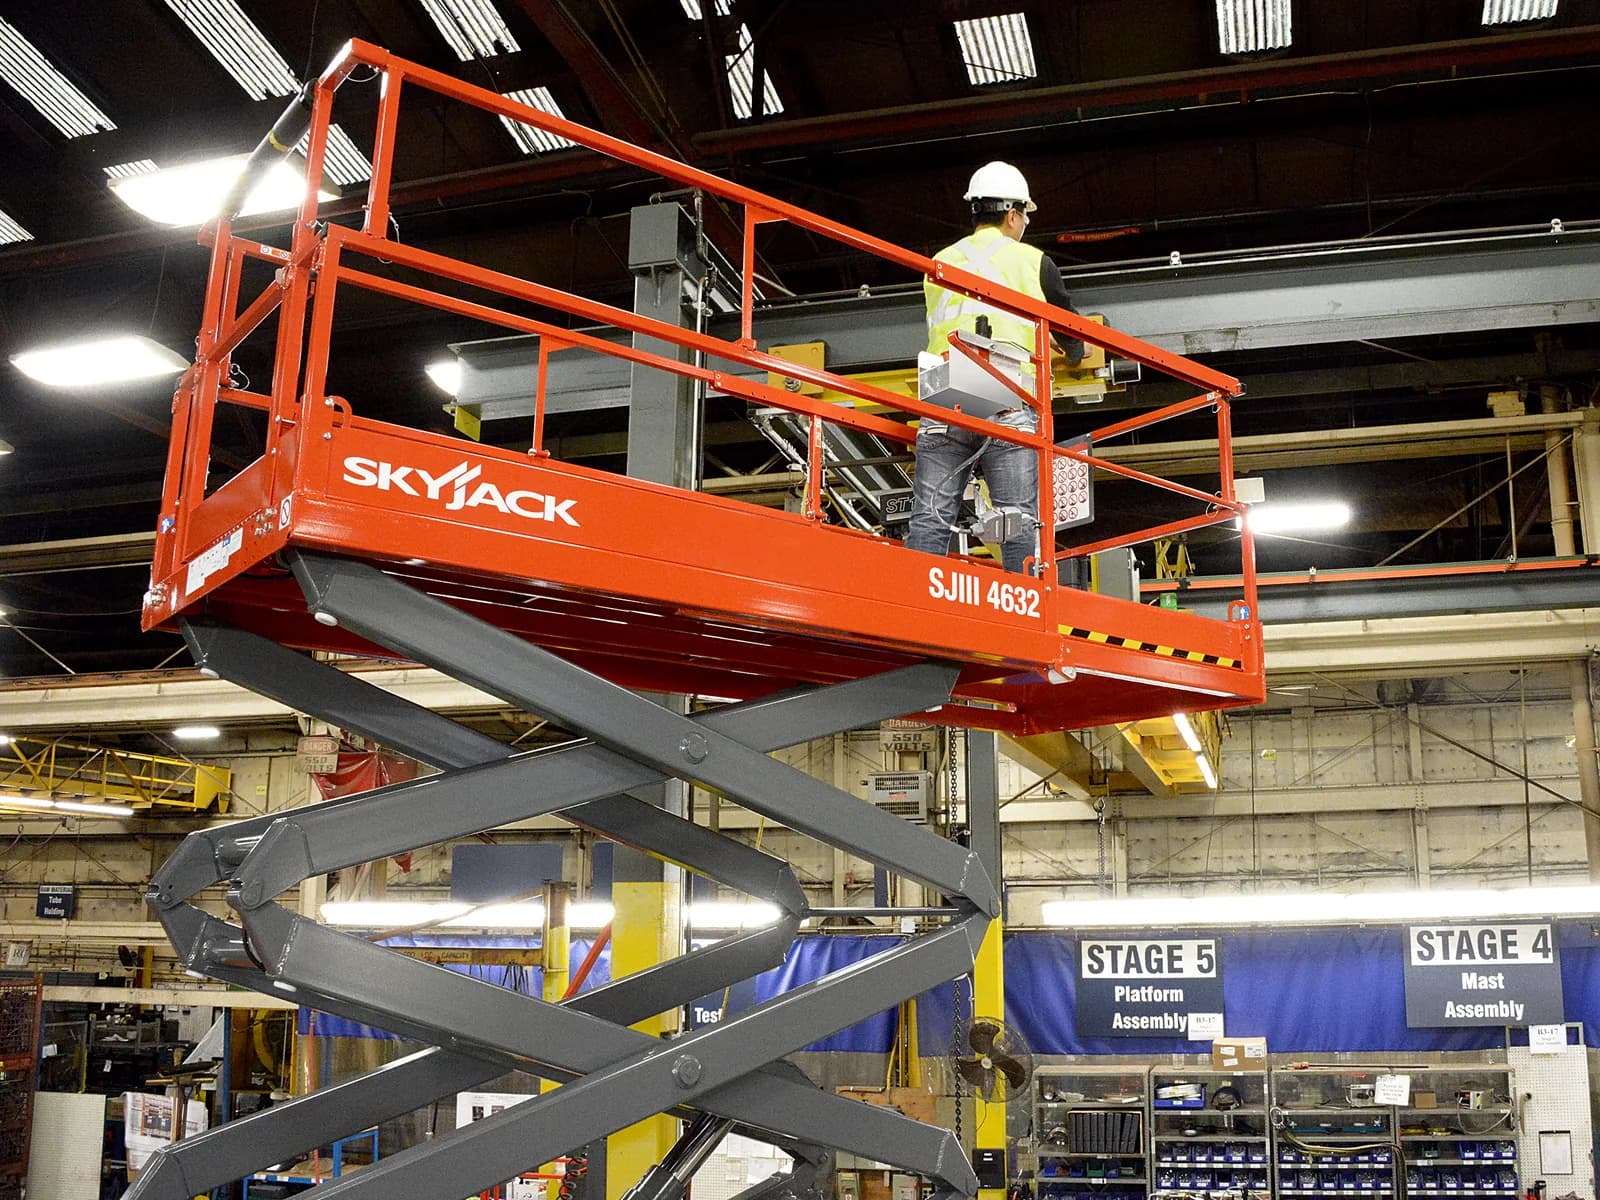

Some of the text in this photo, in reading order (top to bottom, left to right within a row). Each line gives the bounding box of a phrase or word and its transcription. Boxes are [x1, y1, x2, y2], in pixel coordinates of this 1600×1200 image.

[343, 456, 581, 527] SKYJACK
[928, 566, 1041, 618] SJIII 4632
[882, 742, 931, 751] VOLTS
[1416, 928, 1552, 962] STAGE 4
[1087, 944, 1215, 975] STAGE 5
[1461, 972, 1505, 990] Mast
[1114, 985, 1184, 1002] Platform
[1444, 1000, 1525, 1021] Assembly
[1112, 1012, 1188, 1033] Assembly
